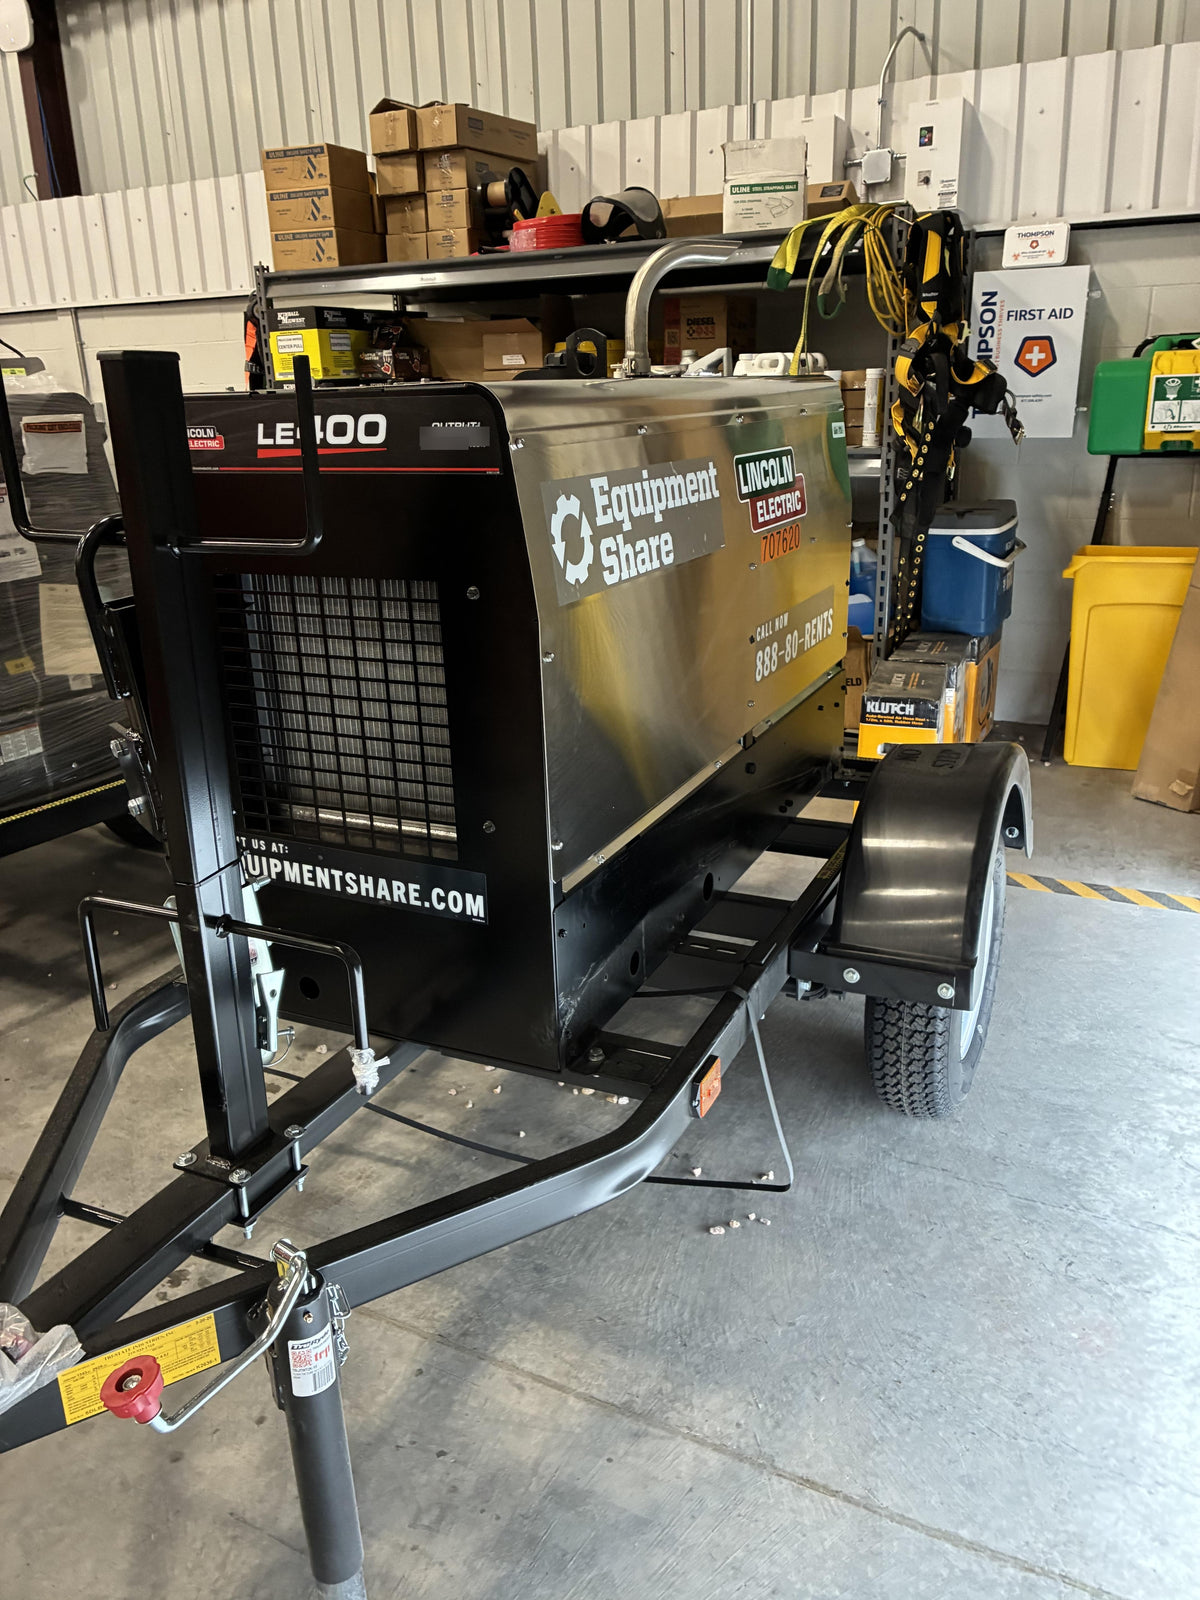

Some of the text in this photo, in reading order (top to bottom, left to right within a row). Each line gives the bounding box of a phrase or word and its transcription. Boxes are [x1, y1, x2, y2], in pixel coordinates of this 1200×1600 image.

[732, 186, 750, 194] ULINE
[1017, 230, 1055, 239] THOMPSON
[686, 317, 716, 326] DIESEL
[1006, 307, 1074, 321] FIRST AID
[738, 454, 794, 494] LINCOLN
[590, 461, 720, 532] Equipment
[756, 490, 802, 523] ELECTRIC
[762, 523, 800, 561] 707620
[600, 532, 675, 586] Share
[756, 612, 789, 642] CALL NOW
[755, 607, 833, 682] 888-80-RENTS
[866, 701, 915, 715] KLUTCH
[252, 838, 266, 851] US
[271, 842, 289, 854] AT:
[241, 853, 485, 918] UIPMENTSHARE.COM
